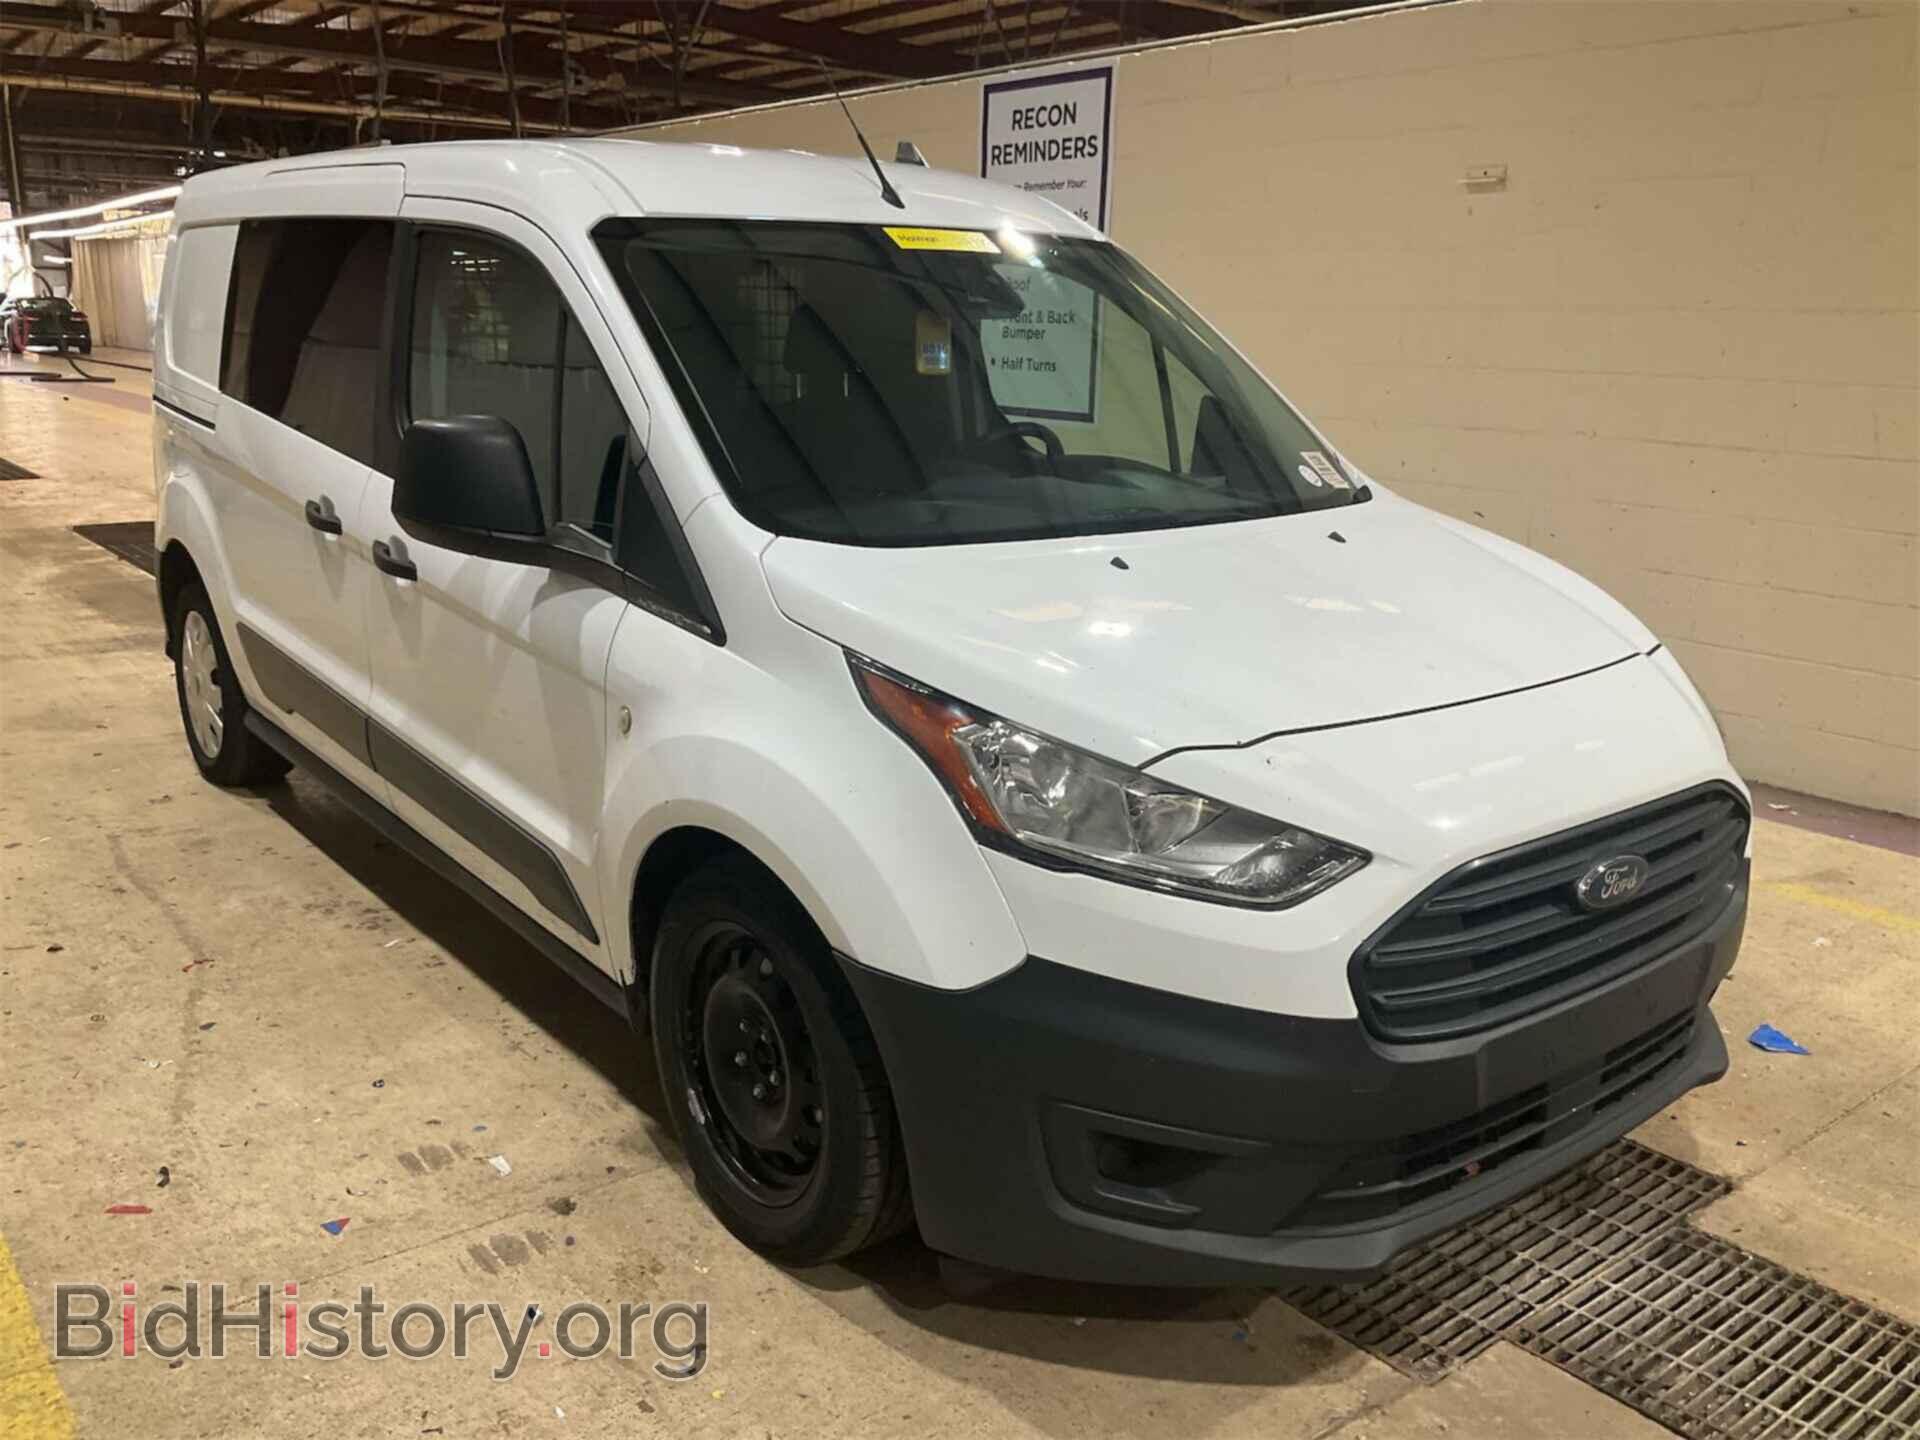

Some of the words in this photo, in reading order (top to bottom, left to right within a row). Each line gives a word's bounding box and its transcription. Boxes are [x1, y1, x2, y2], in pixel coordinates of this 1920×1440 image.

[1012, 101, 1077, 131] RECON
[991, 135, 1098, 166] REMINDERS
[1023, 179, 1065, 192] Remember
[1036, 310, 1043, 324] &
[1047, 310, 1076, 324] Back
[1002, 325, 1046, 341] Bumper
[1001, 357, 1024, 371] Half
[1026, 357, 1056, 372] Turns
[1601, 866, 1637, 899] Ford
